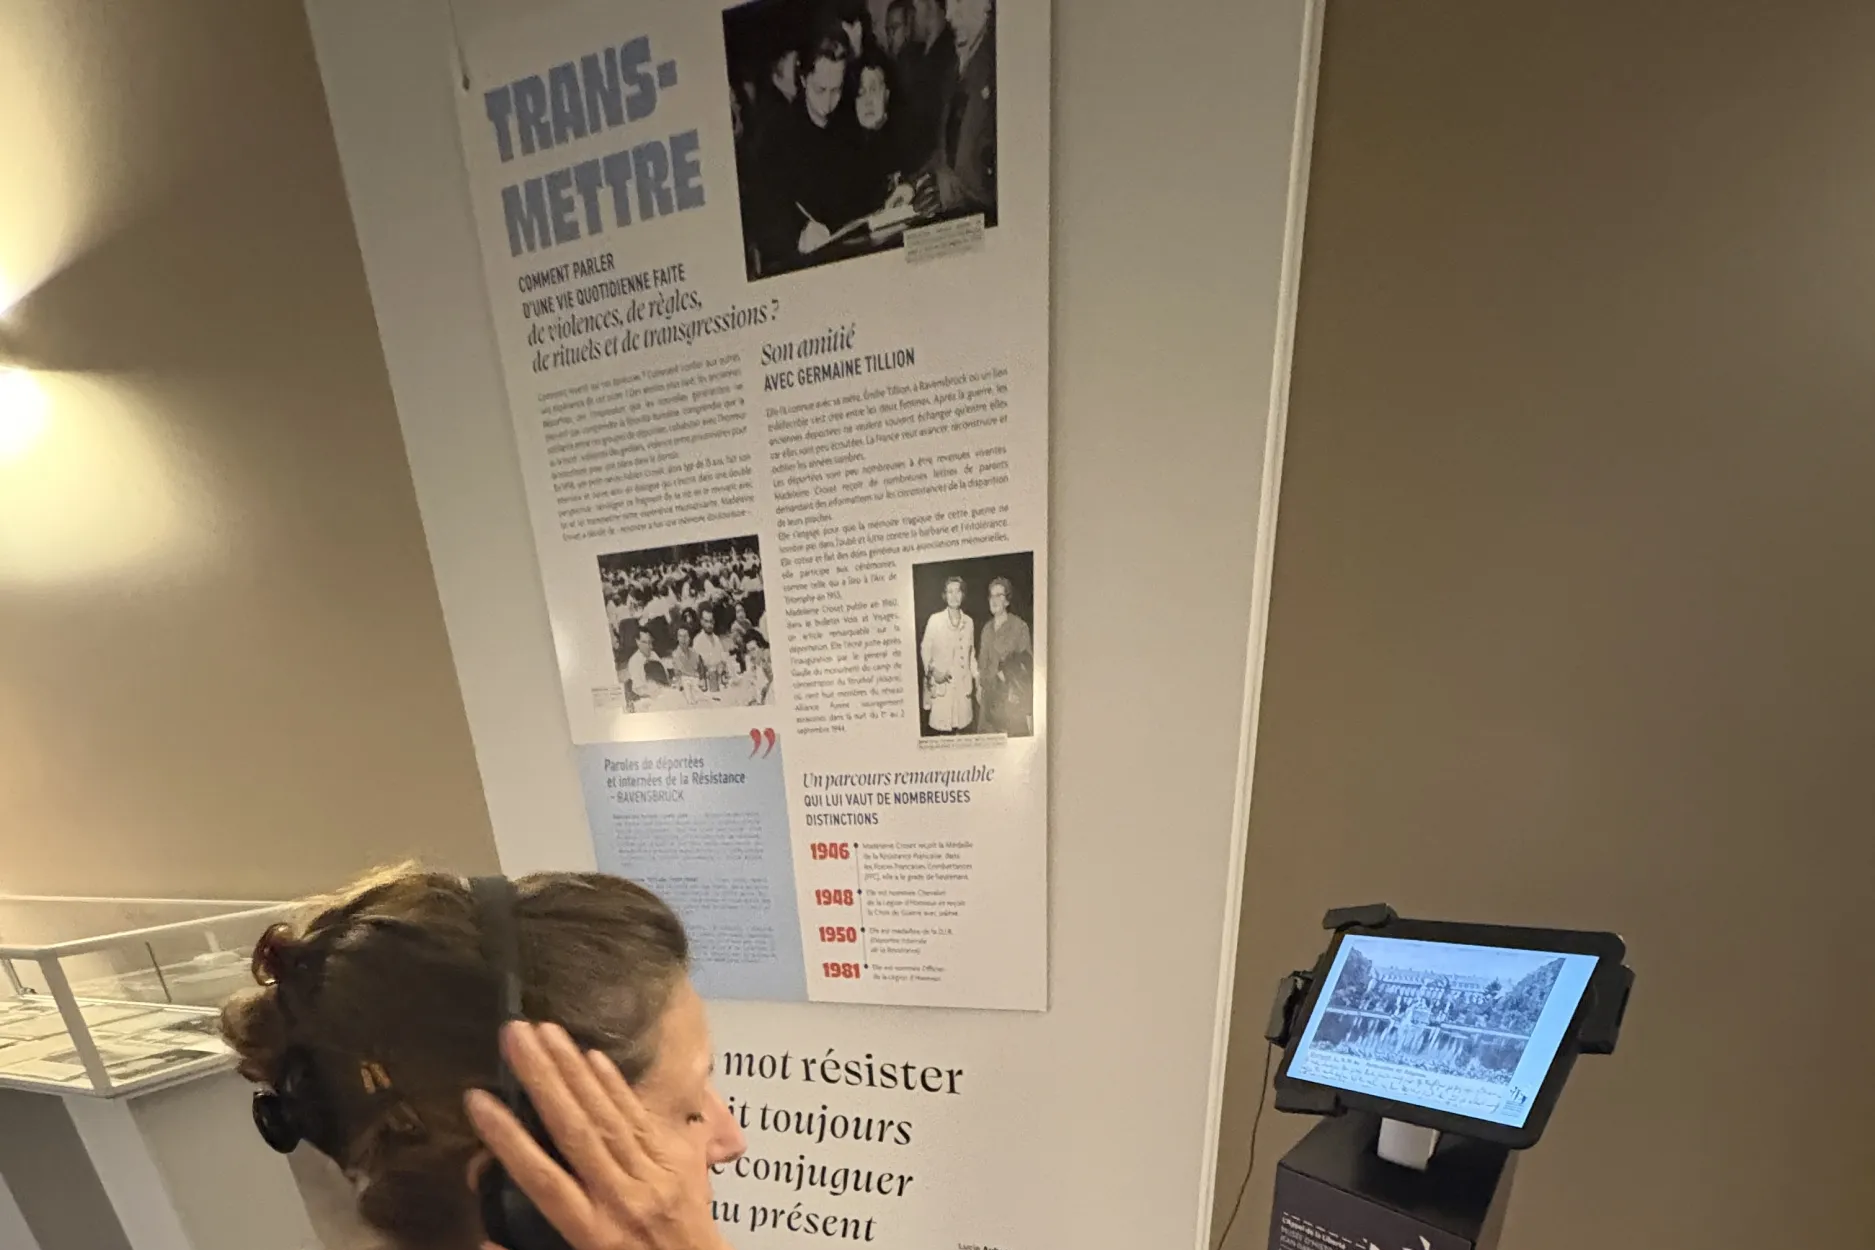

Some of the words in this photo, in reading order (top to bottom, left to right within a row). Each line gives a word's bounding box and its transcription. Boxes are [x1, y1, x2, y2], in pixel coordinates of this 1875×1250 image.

[484, 34, 678, 164] TRANS-
[501, 128, 706, 258] METTRE
[518, 264, 571, 293] COMMENT
[573, 253, 615, 278] PARLER
[522, 295, 555, 319] D'UNE
[556, 291, 574, 311] VIE
[577, 274, 650, 306] QUOTIDIENNE
[652, 263, 686, 287] FAITE
[527, 322, 546, 346] de
[548, 307, 624, 340] violences,
[626, 298, 644, 322] de
[649, 289, 702, 321] règles,
[532, 349, 550, 373] de
[552, 341, 601, 368] rituels
[604, 337, 619, 357] et
[622, 330, 640, 352] de
[643, 304, 768, 347] transgressions
[761, 341, 793, 368] Son
[797, 322, 856, 360] amitié
[763, 373, 794, 392] AVEC
[797, 358, 861, 386] GERMAINE
[865, 347, 915, 373] TILLION
[604, 757, 640, 772] Paroles
[641, 755, 654, 770] de
[656, 754, 704, 774] déportées
[607, 777, 617, 788] et
[618, 774, 662, 787] internées
[665, 773, 677, 786] de
[679, 772, 689, 785] la
[692, 770, 746, 785] Résistance
[802, 772, 823, 789] Un
[824, 772, 892, 791] parcours
[894, 764, 995, 788] remarquable
[803, 794, 824, 808] QUI
[825, 793, 844, 808] LUI
[845, 793, 874, 807] VAUT
[877, 792, 892, 806] DE
[893, 789, 971, 805] NOMBREUSES
[805, 812, 879, 826] DISTINCTIONS
[810, 842, 850, 860] 1946
[815, 888, 855, 906] 1948
[818, 926, 857, 943] 1950
[822, 962, 861, 979] 1981
[724, 1050, 793, 1080] mot
[801, 1048, 964, 1095] résister
[759, 1103, 914, 1146] toujours
[735, 1154, 914, 1197] conjuguer
[749, 1201, 877, 1242] présent
